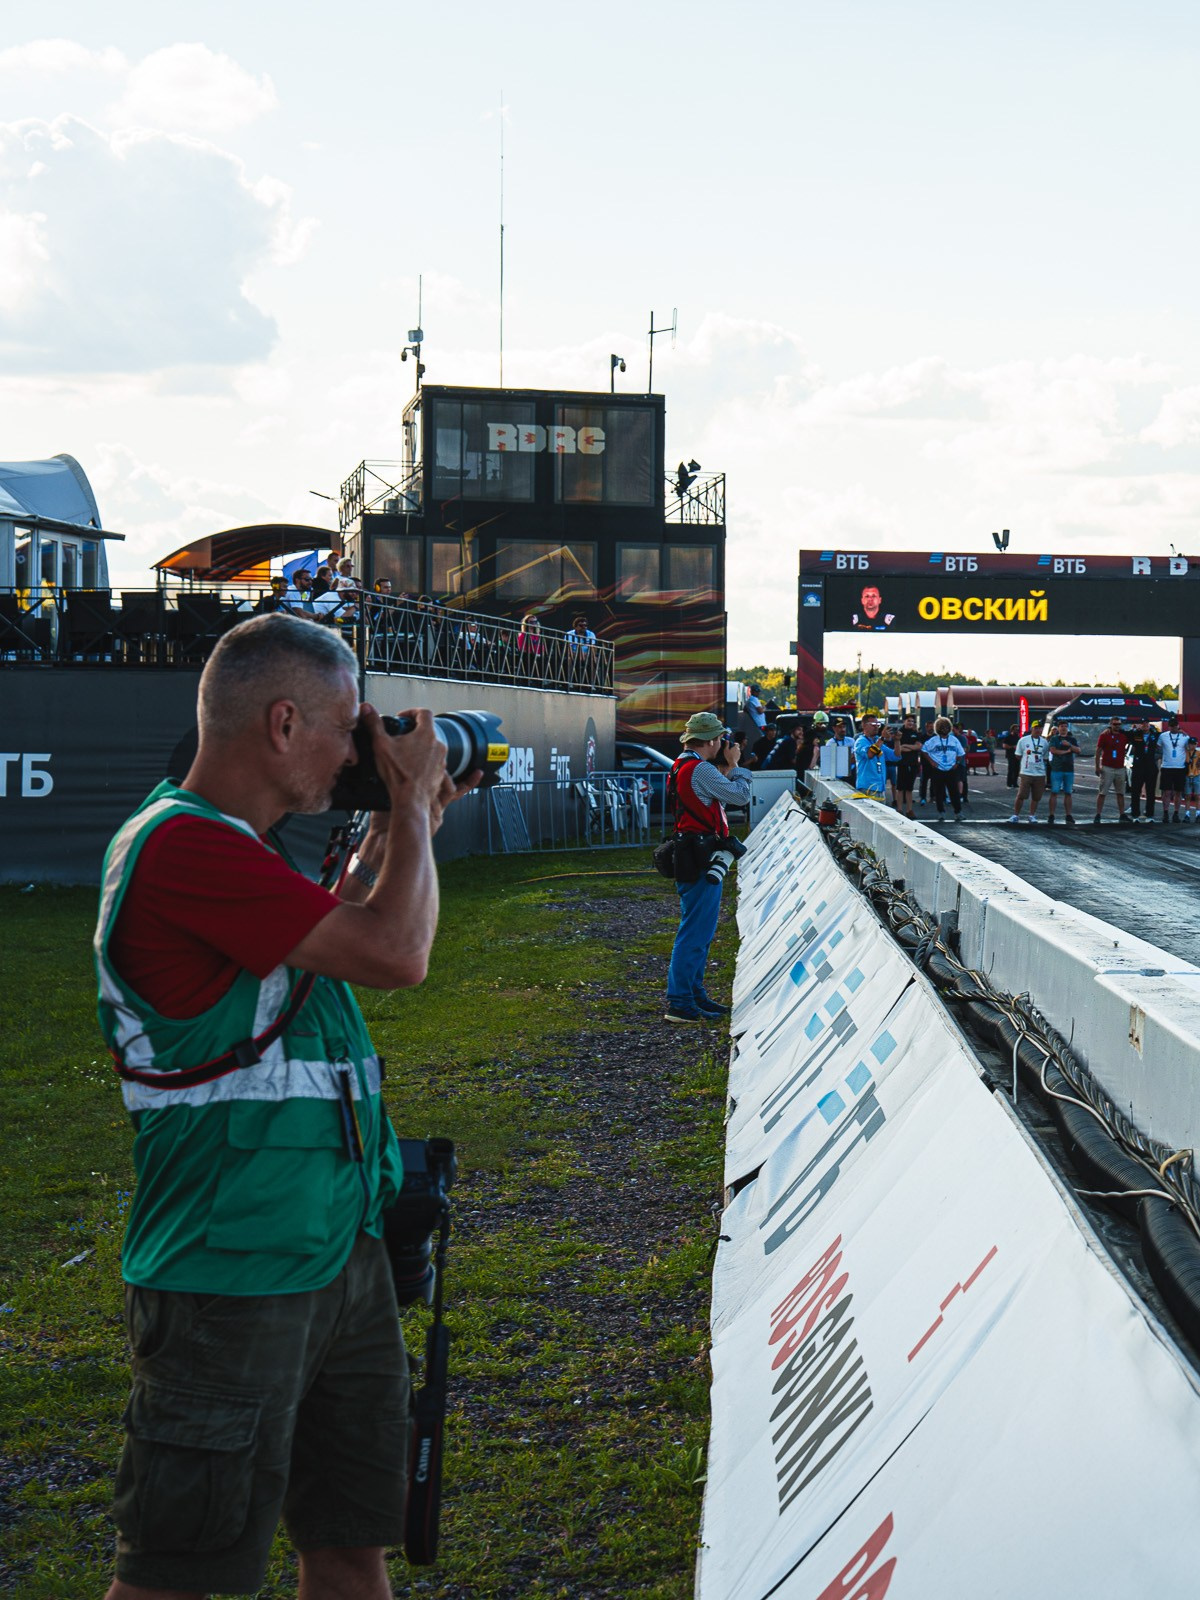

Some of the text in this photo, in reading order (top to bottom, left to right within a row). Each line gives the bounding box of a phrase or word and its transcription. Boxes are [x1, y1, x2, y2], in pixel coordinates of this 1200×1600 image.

[486, 422, 606, 455] RDRC
[836, 554, 869, 570] ВТБ
[945, 557, 978, 572] ВТБ
[1054, 558, 1086, 574] ВТБ
[0, 753, 54, 797] ТБ
[499, 747, 534, 791] DRC
[768, 1233, 874, 1517] ROSGONKI
[416, 1438, 431, 1482] Canon
